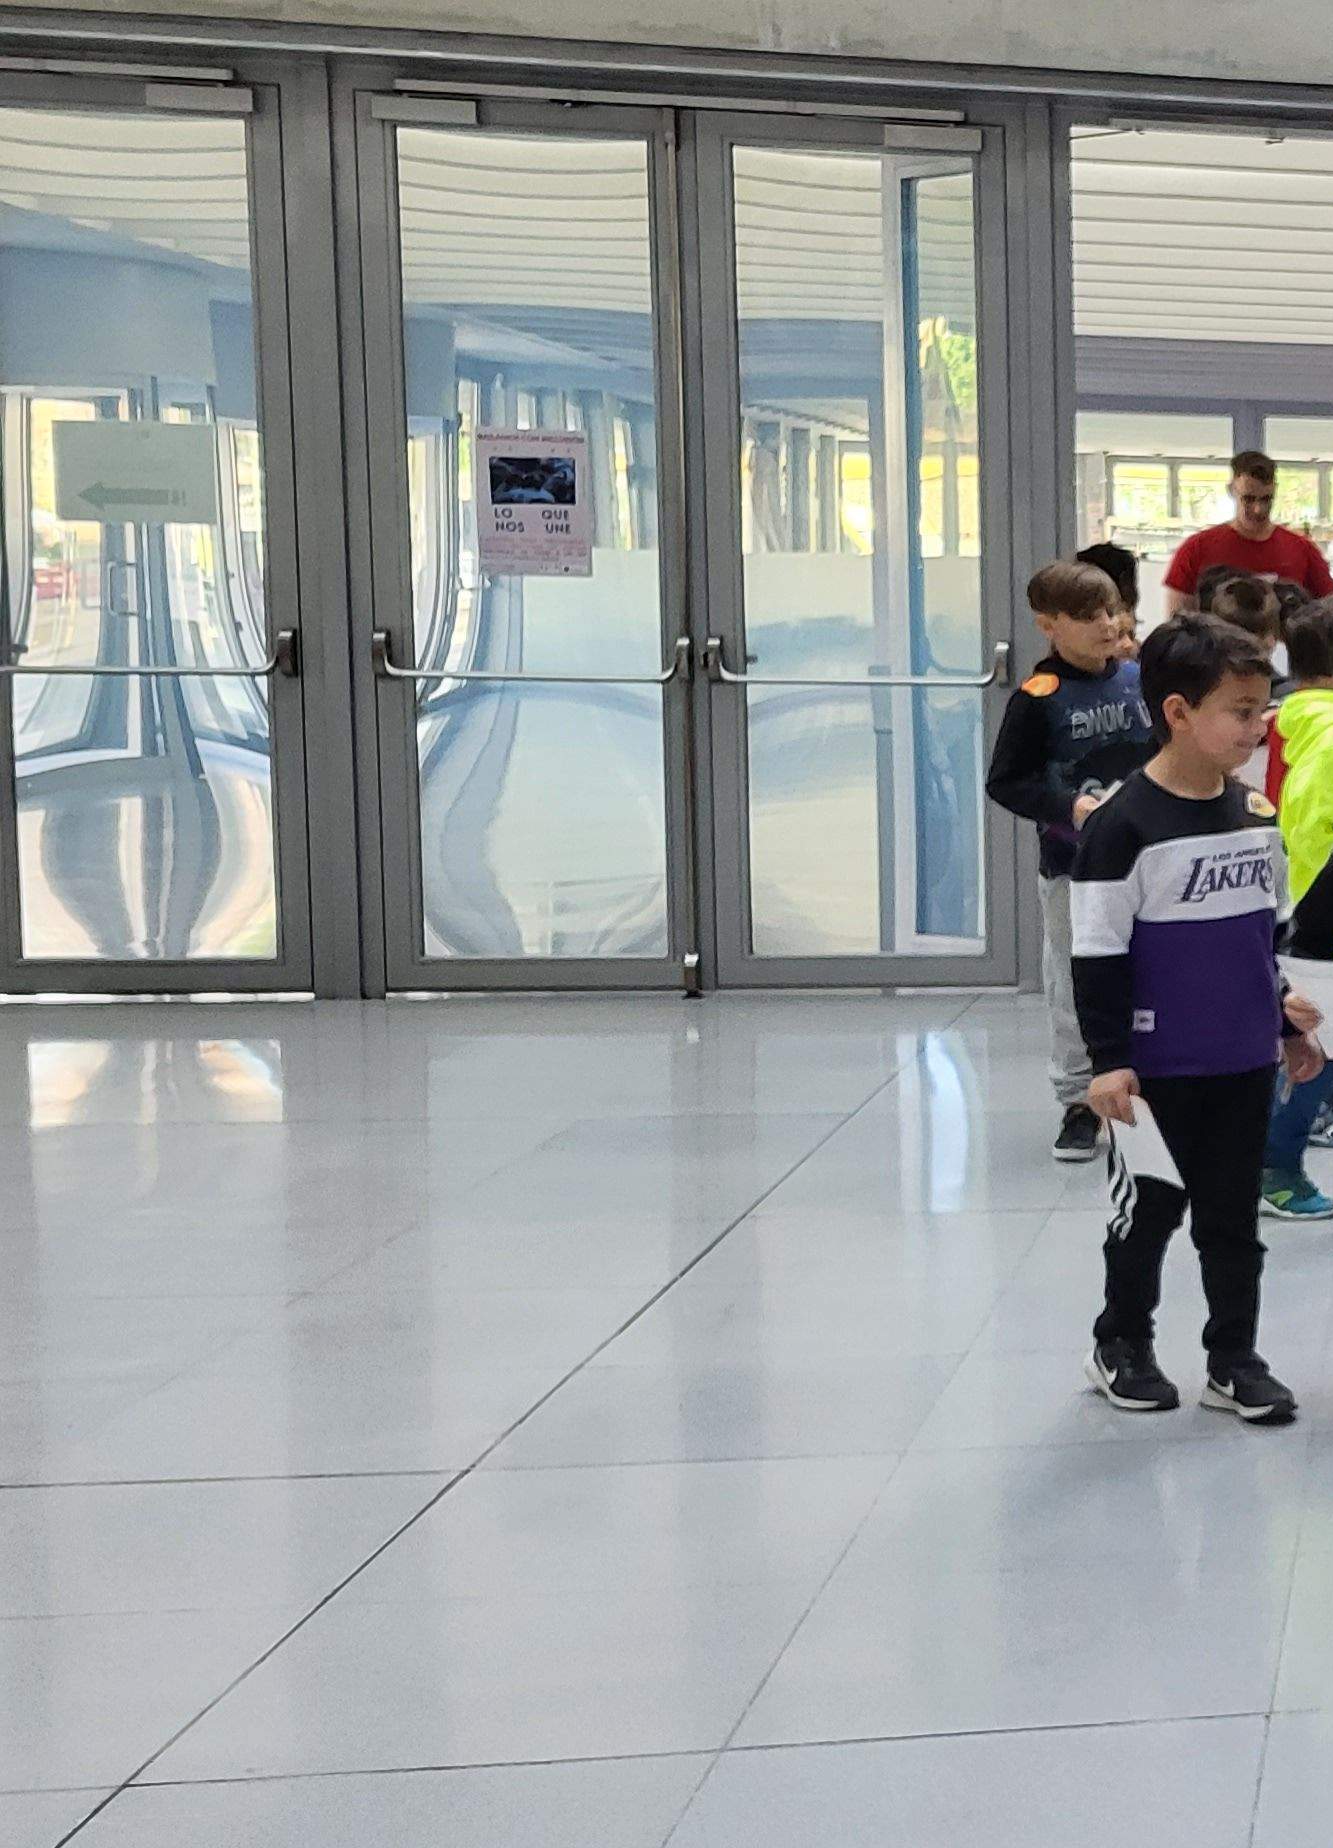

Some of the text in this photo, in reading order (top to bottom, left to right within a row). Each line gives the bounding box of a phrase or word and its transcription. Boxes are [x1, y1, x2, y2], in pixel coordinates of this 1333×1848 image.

[494, 507, 570, 520] LO QUE
[495, 521, 571, 534] NOS UNE
[1178, 856, 1274, 903] LAKERS
